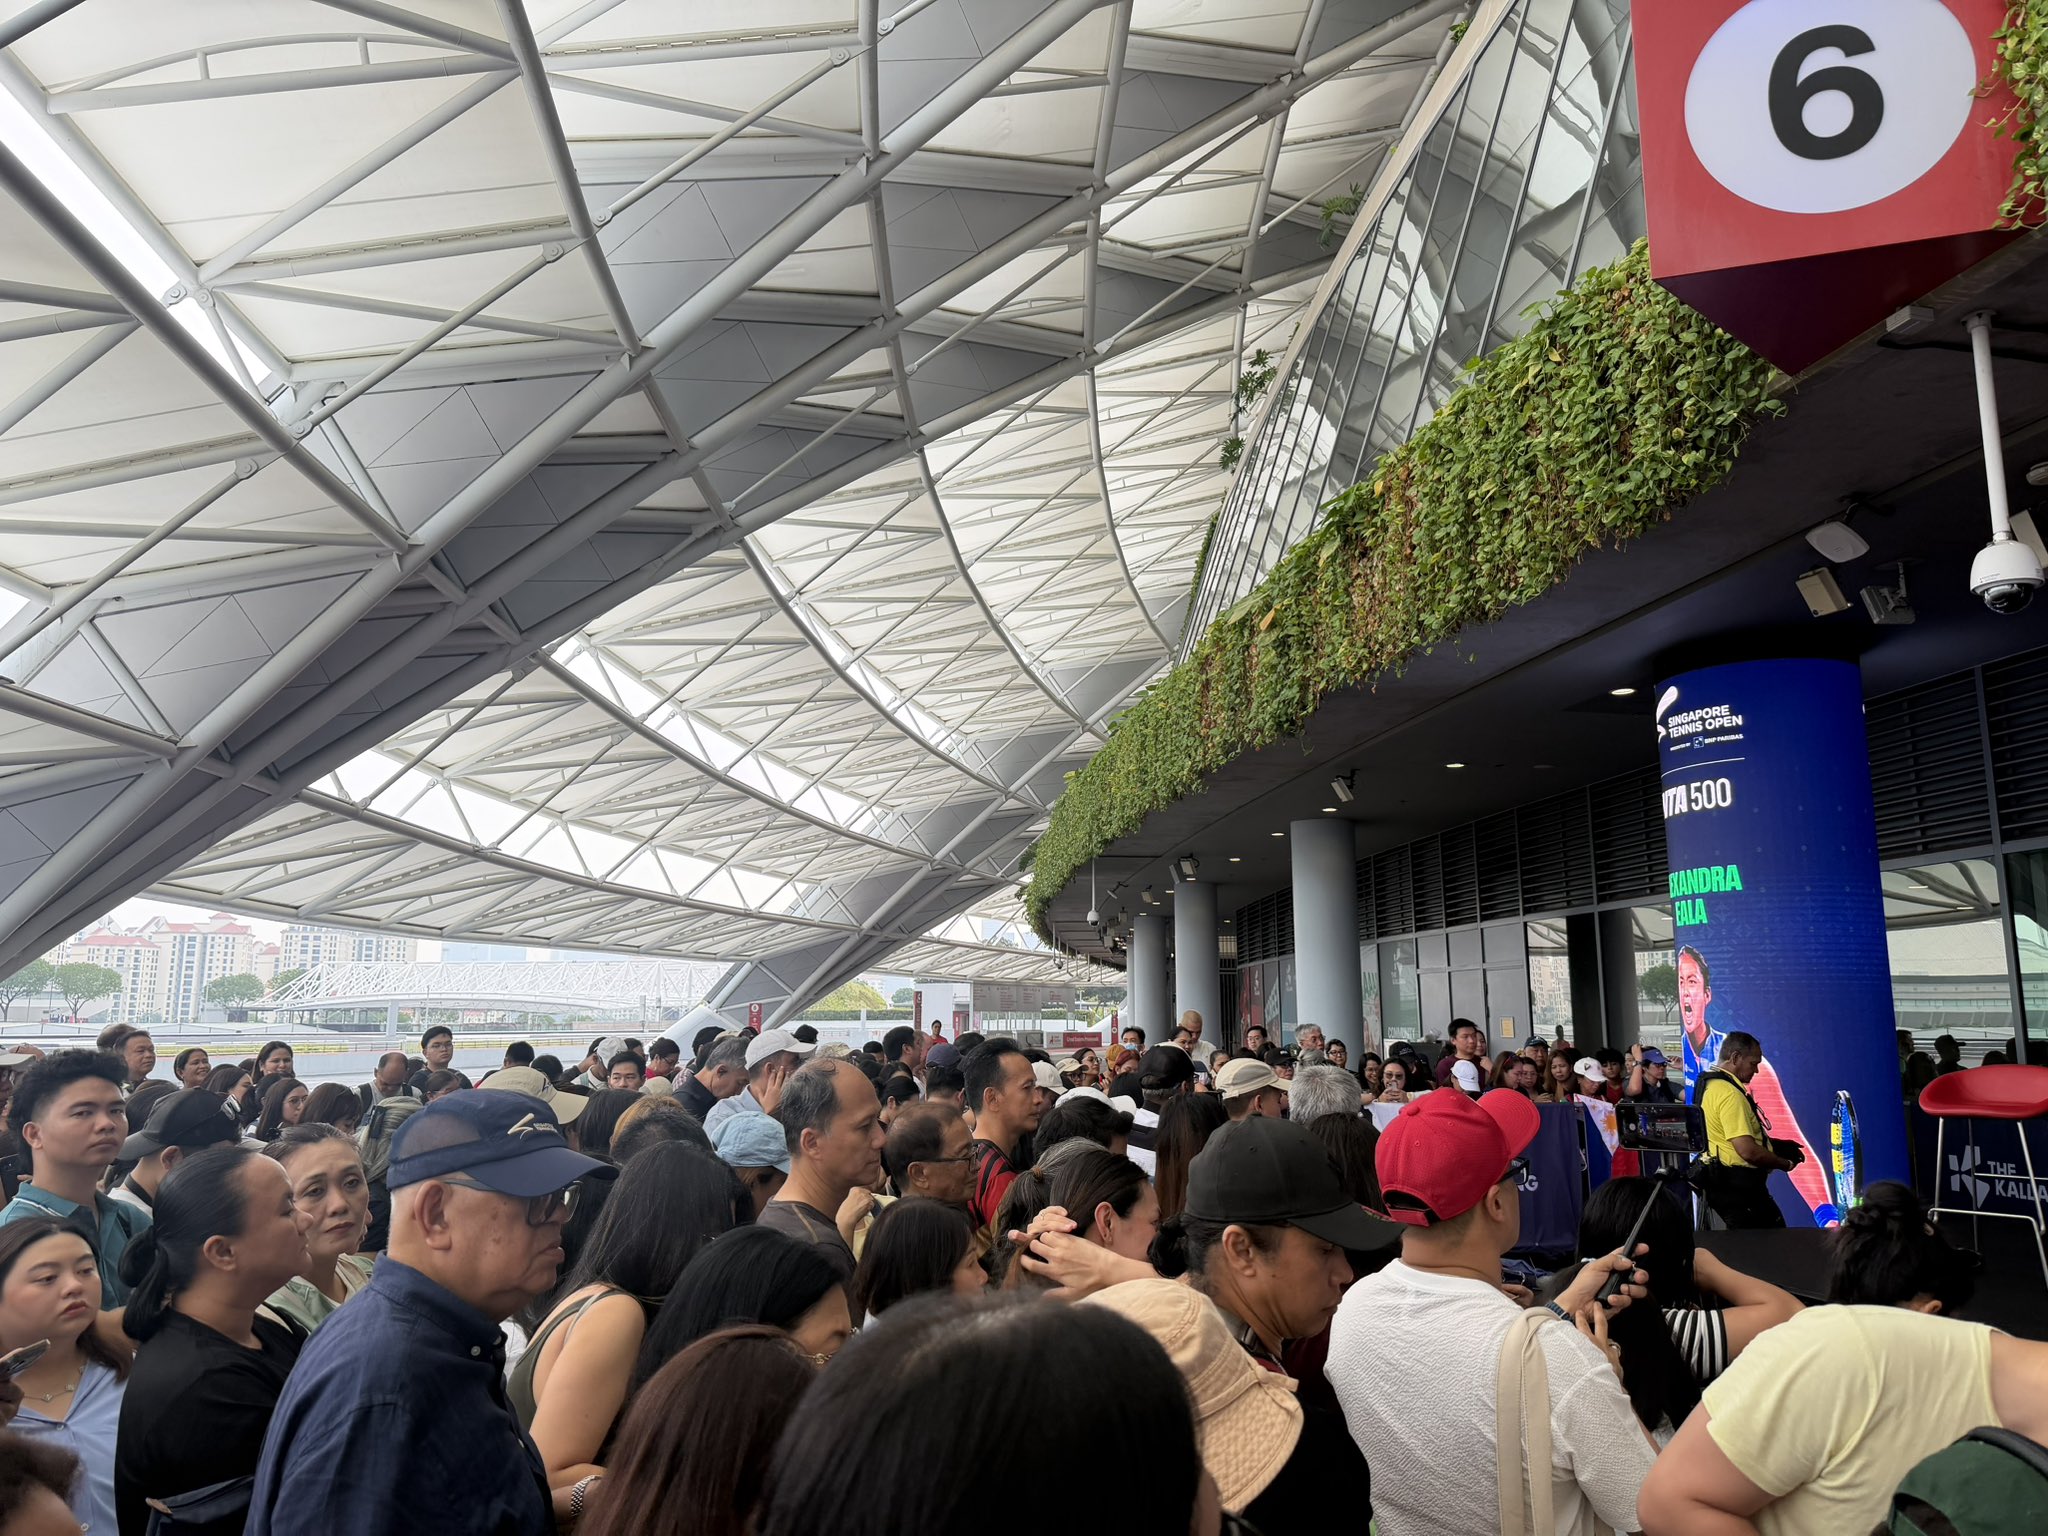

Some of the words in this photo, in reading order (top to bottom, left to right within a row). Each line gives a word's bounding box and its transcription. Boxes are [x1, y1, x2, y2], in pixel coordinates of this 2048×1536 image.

[1768, 24, 1885, 161] 6
[1668, 705, 1730, 727] SINGAPORE
[1668, 721, 1703, 738] TENNIS
[1705, 715, 1743, 730] OPEN
[1690, 778, 1732, 811] 500
[1675, 898, 1708, 927] EALA
[1987, 1160, 2017, 1176] THE
